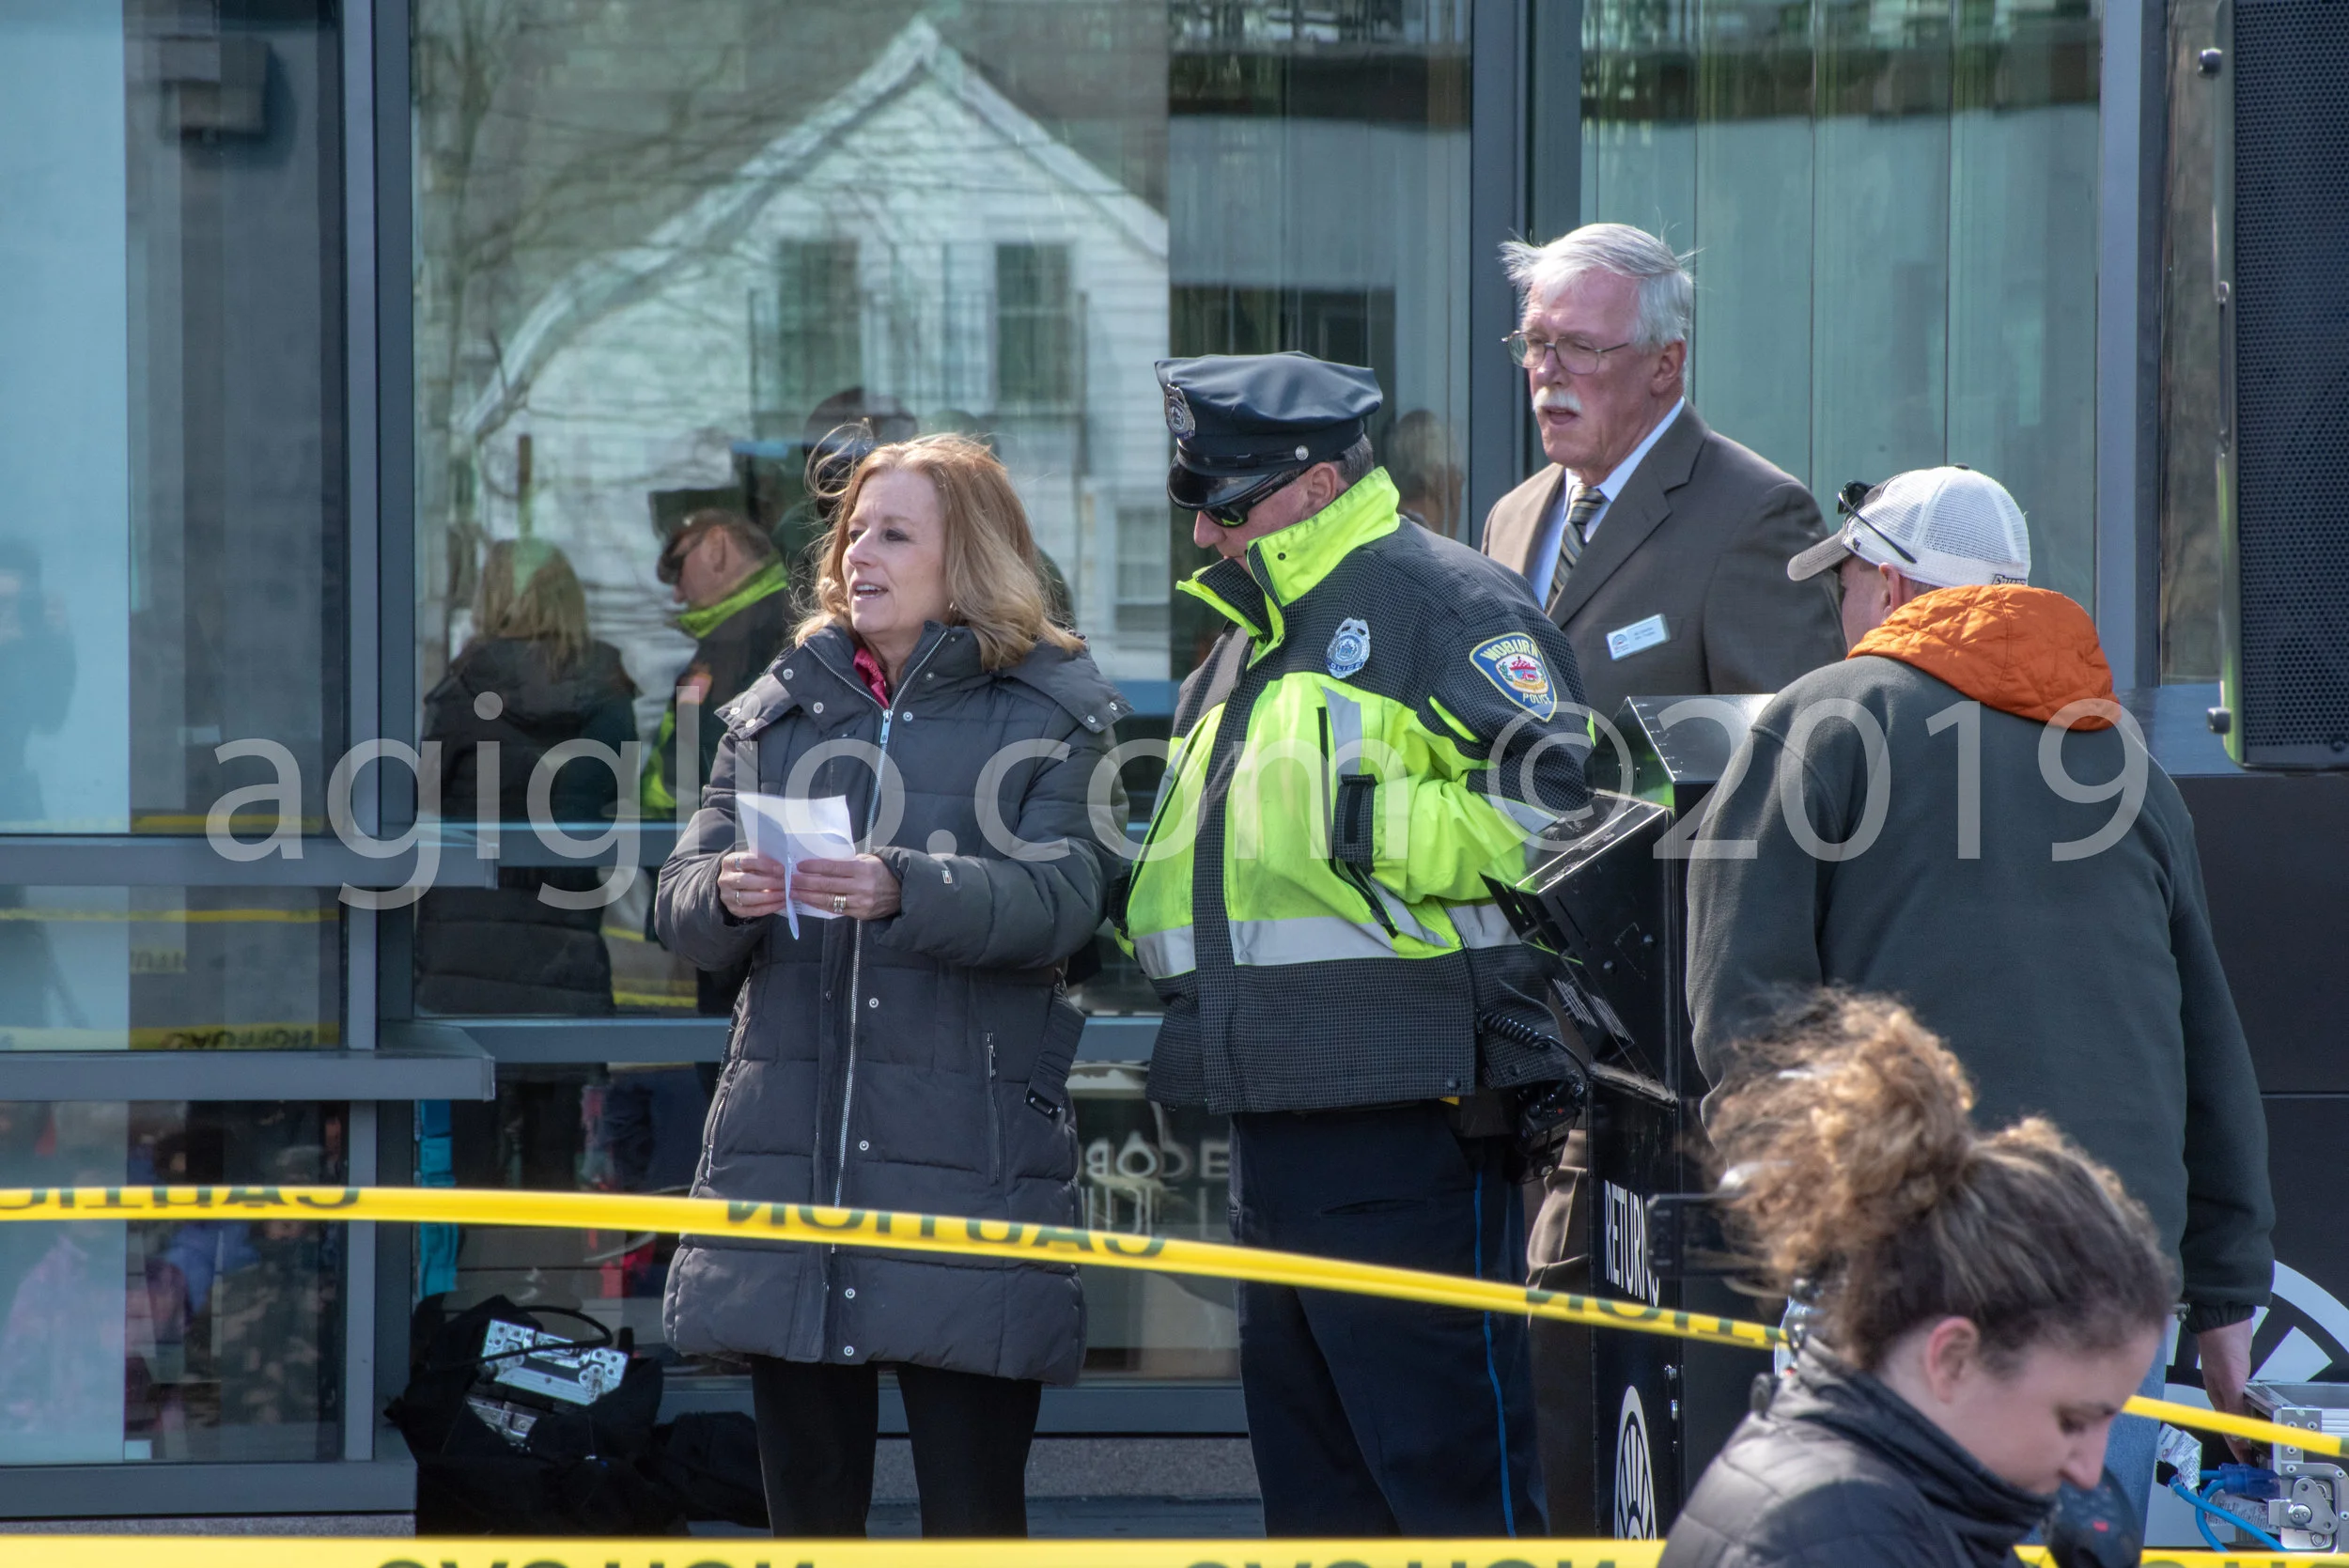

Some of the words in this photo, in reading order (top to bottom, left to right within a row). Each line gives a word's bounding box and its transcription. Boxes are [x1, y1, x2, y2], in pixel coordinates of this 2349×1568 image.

[1480, 639, 1540, 661] WOBURN
[1522, 692, 1552, 706] POLICE
[1604, 1178, 1660, 1308] RETURN
